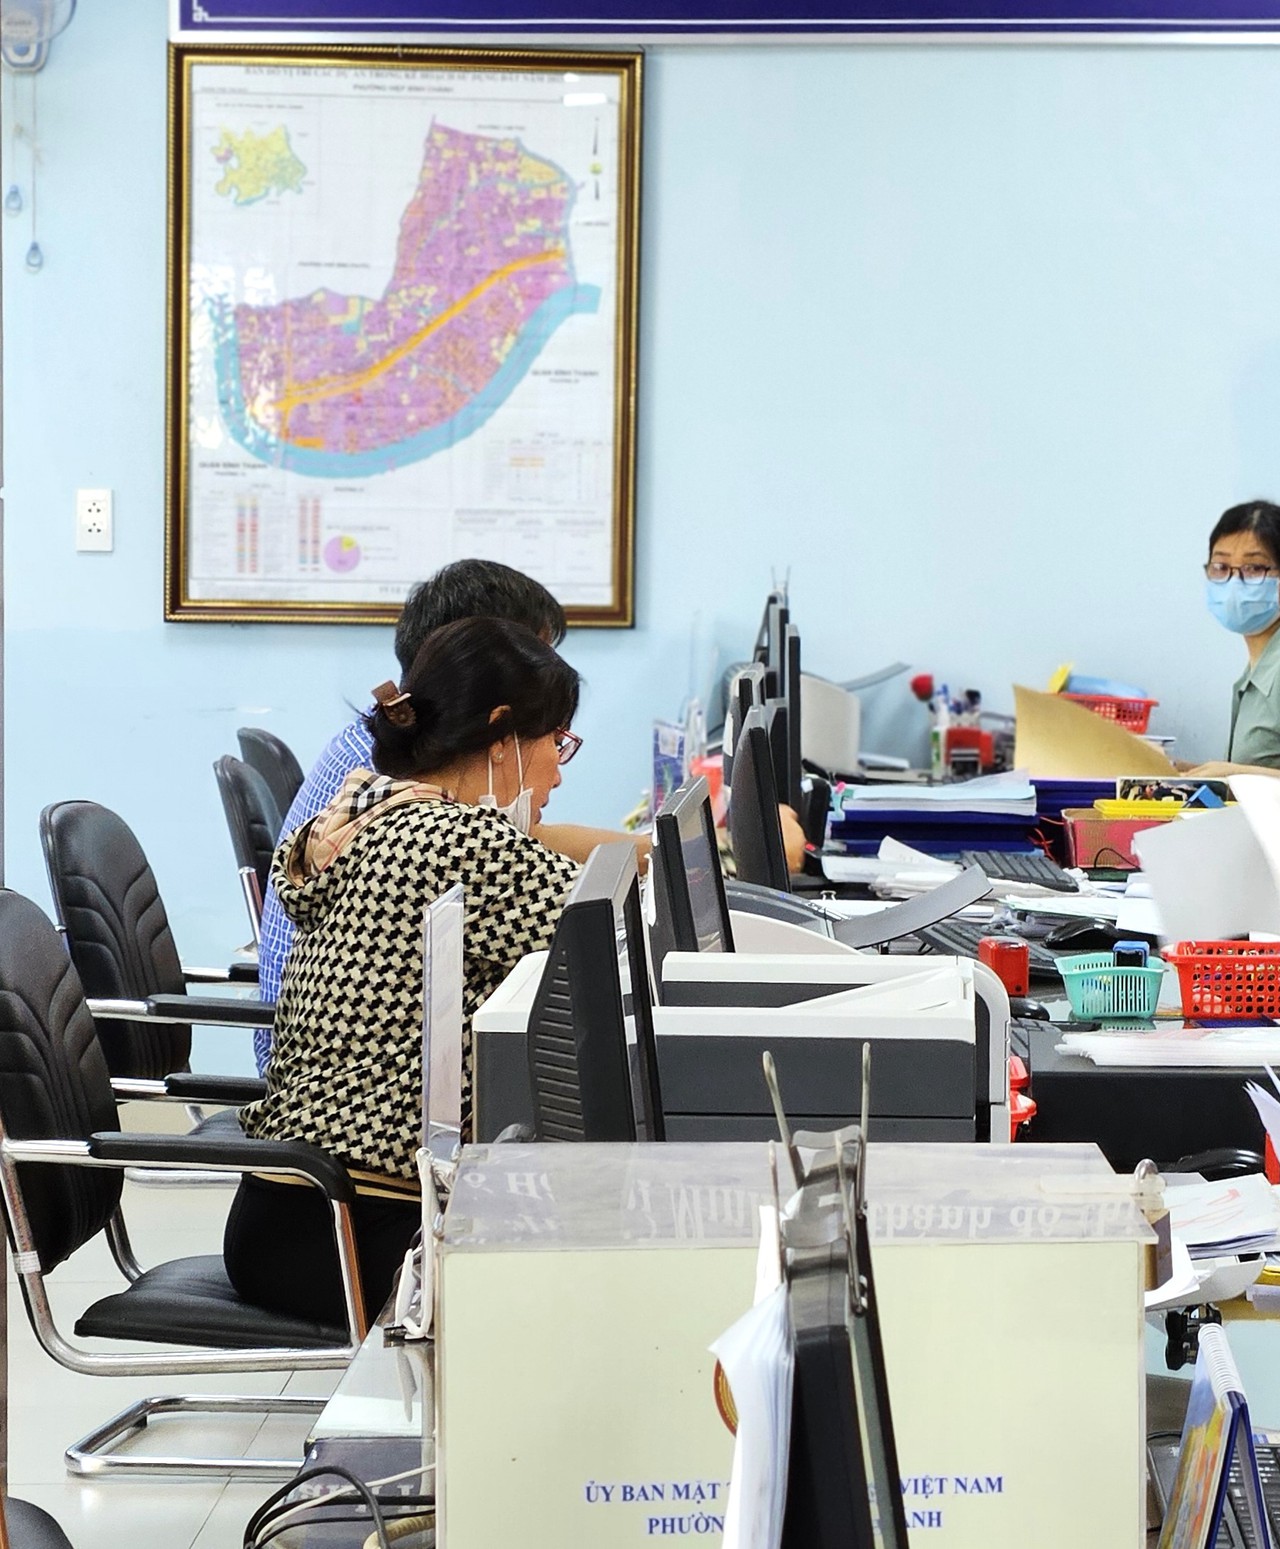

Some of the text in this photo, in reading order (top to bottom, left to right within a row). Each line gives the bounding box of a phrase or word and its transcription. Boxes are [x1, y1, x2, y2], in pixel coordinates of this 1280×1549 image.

[585, 1475, 1003, 1504] ỦY BAN MẶT VIỆT NAM
[647, 1511, 725, 1534] PHƯỜN
